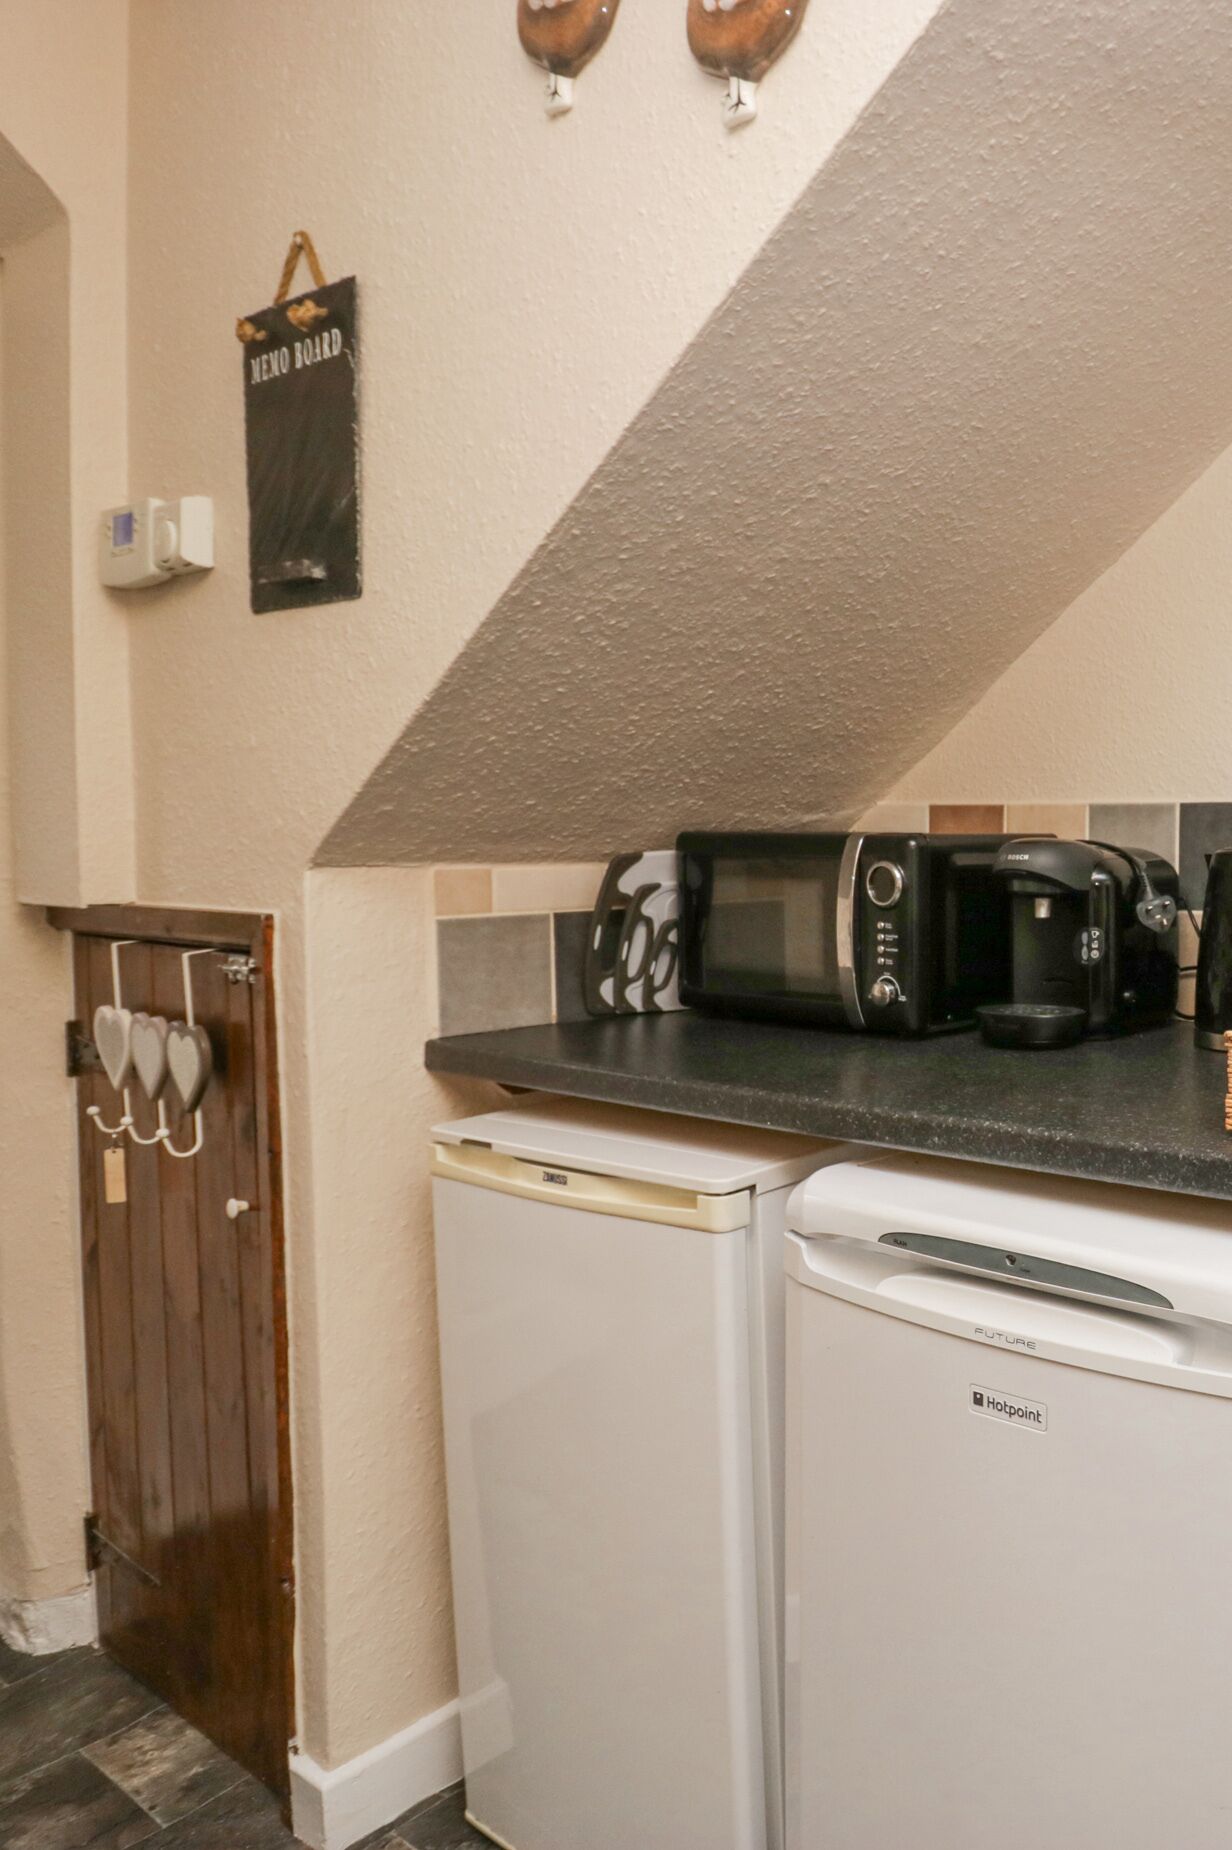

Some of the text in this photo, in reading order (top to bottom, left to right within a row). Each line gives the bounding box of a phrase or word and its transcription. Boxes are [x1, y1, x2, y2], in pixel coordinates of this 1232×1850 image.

[250, 327, 342, 385] MEMO BOARD
[974, 1327, 1037, 1350] FUTURE
[986, 1395, 1042, 1424] Hotpoint
